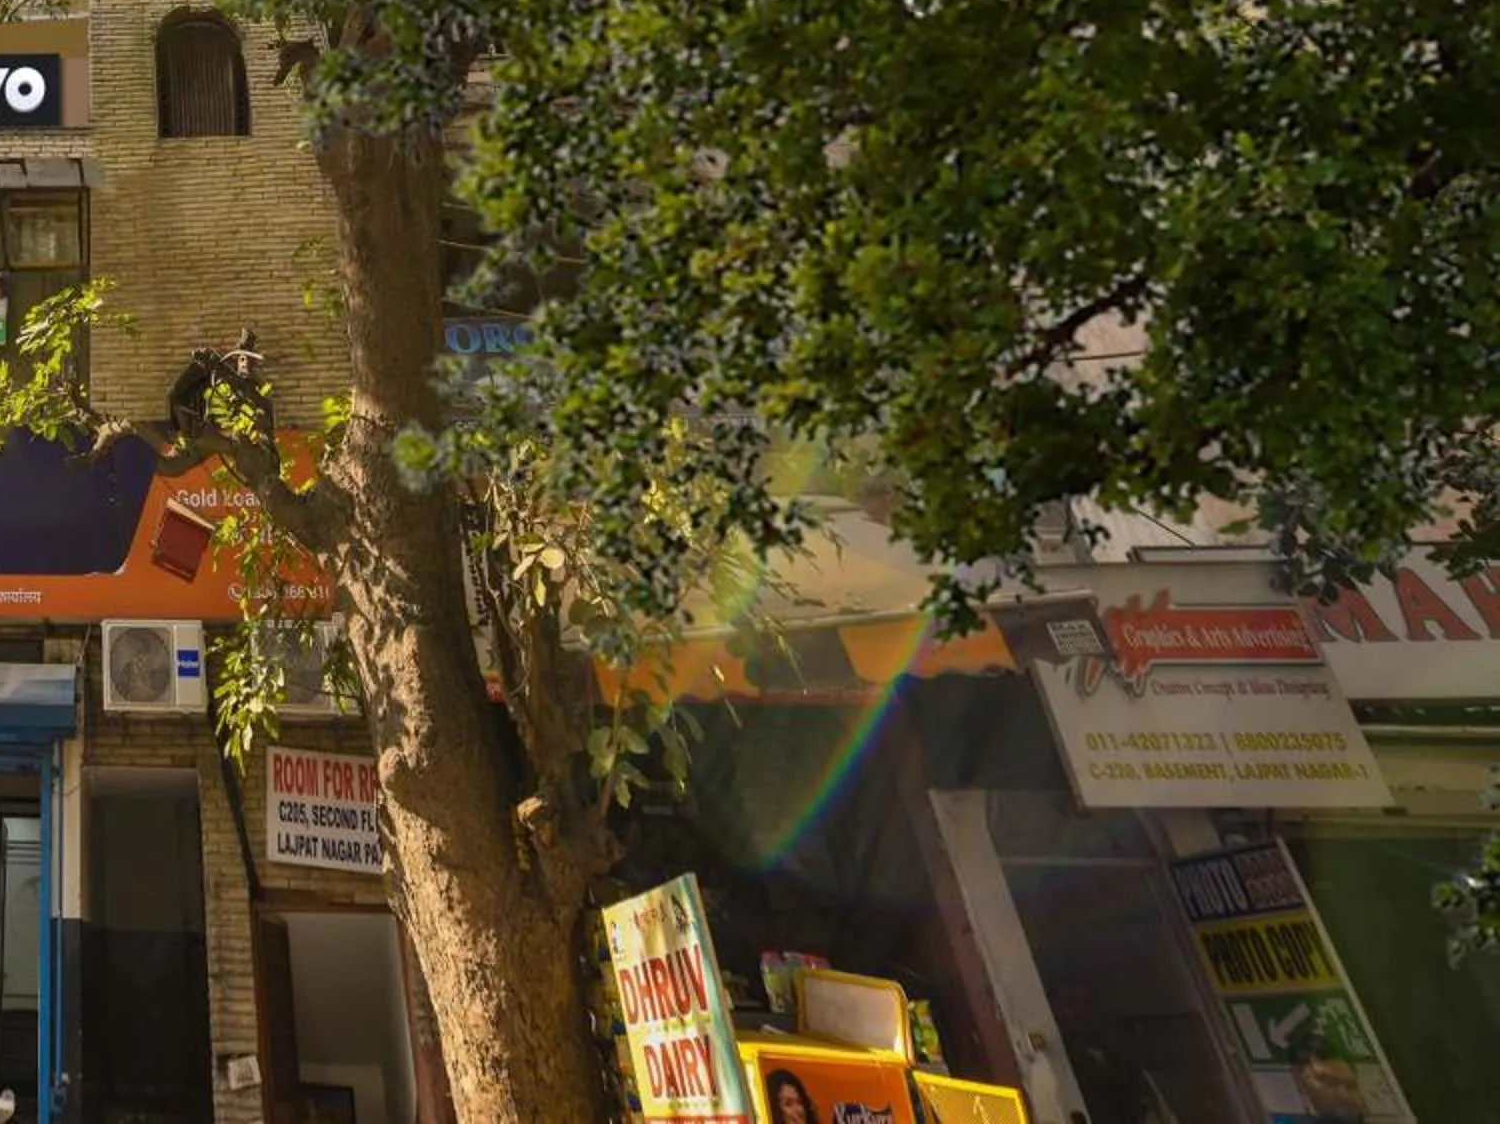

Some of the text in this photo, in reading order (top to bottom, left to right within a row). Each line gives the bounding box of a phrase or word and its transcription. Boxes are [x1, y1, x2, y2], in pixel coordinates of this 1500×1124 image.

[177, 489, 260, 508] Gold Loa
[273, 754, 318, 796] ROOM
[323, 760, 354, 801] FOR
[312, 805, 358, 830] SECOND
[277, 832, 318, 857] LAJPAT
[321, 838, 361, 863] NAGAR
[1201, 921, 1336, 987] PHOTO COPY
[619, 943, 708, 1025] DHRUV
[643, 1035, 718, 1099] DAIRY
